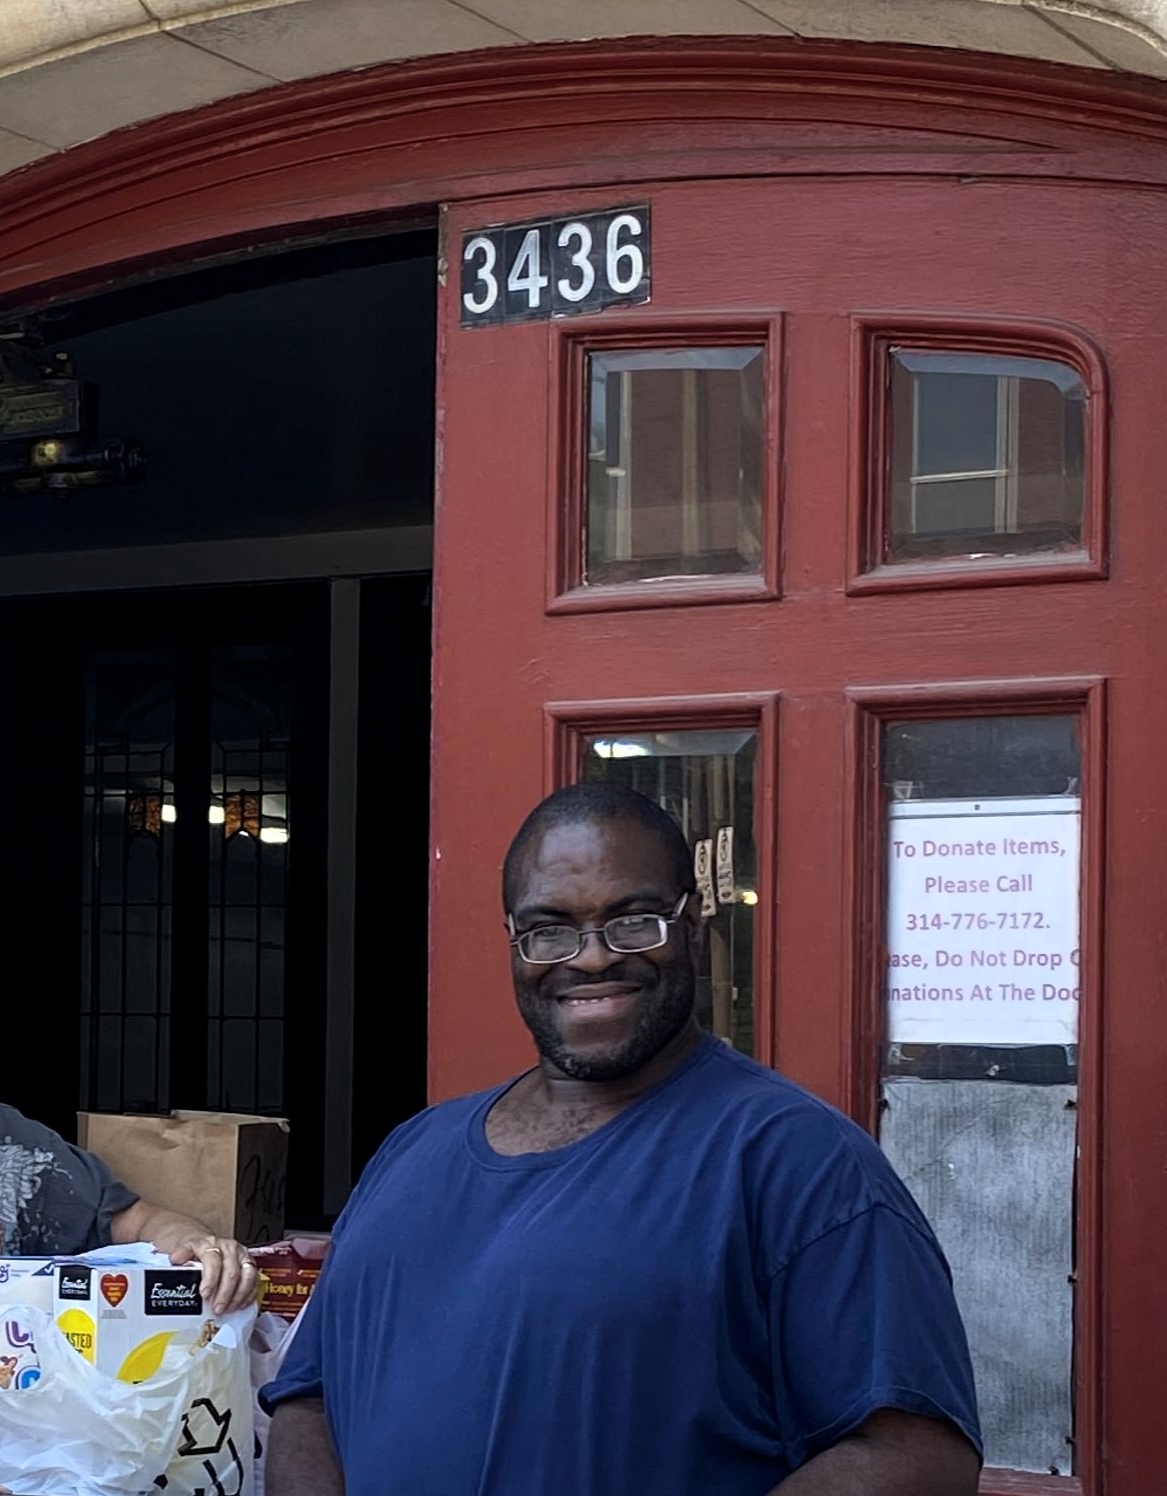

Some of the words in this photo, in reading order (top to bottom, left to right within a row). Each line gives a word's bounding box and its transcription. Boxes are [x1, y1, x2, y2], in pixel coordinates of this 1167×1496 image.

[462, 214, 644, 314] 3436
[893, 841, 916, 858] To
[923, 839, 997, 857] Donate
[1003, 838, 1066, 857] Items,
[925, 876, 990, 894] Please
[996, 874, 1033, 893] Call
[906, 912, 1051, 931] 314-776-7172.
[936, 951, 963, 967] Do
[971, 950, 1007, 967] Not
[1013, 949, 1063, 970] Drop
[970, 985, 993, 1000] At
[998, 984, 1036, 1000] The
[150, 1282, 197, 1299] Essential
